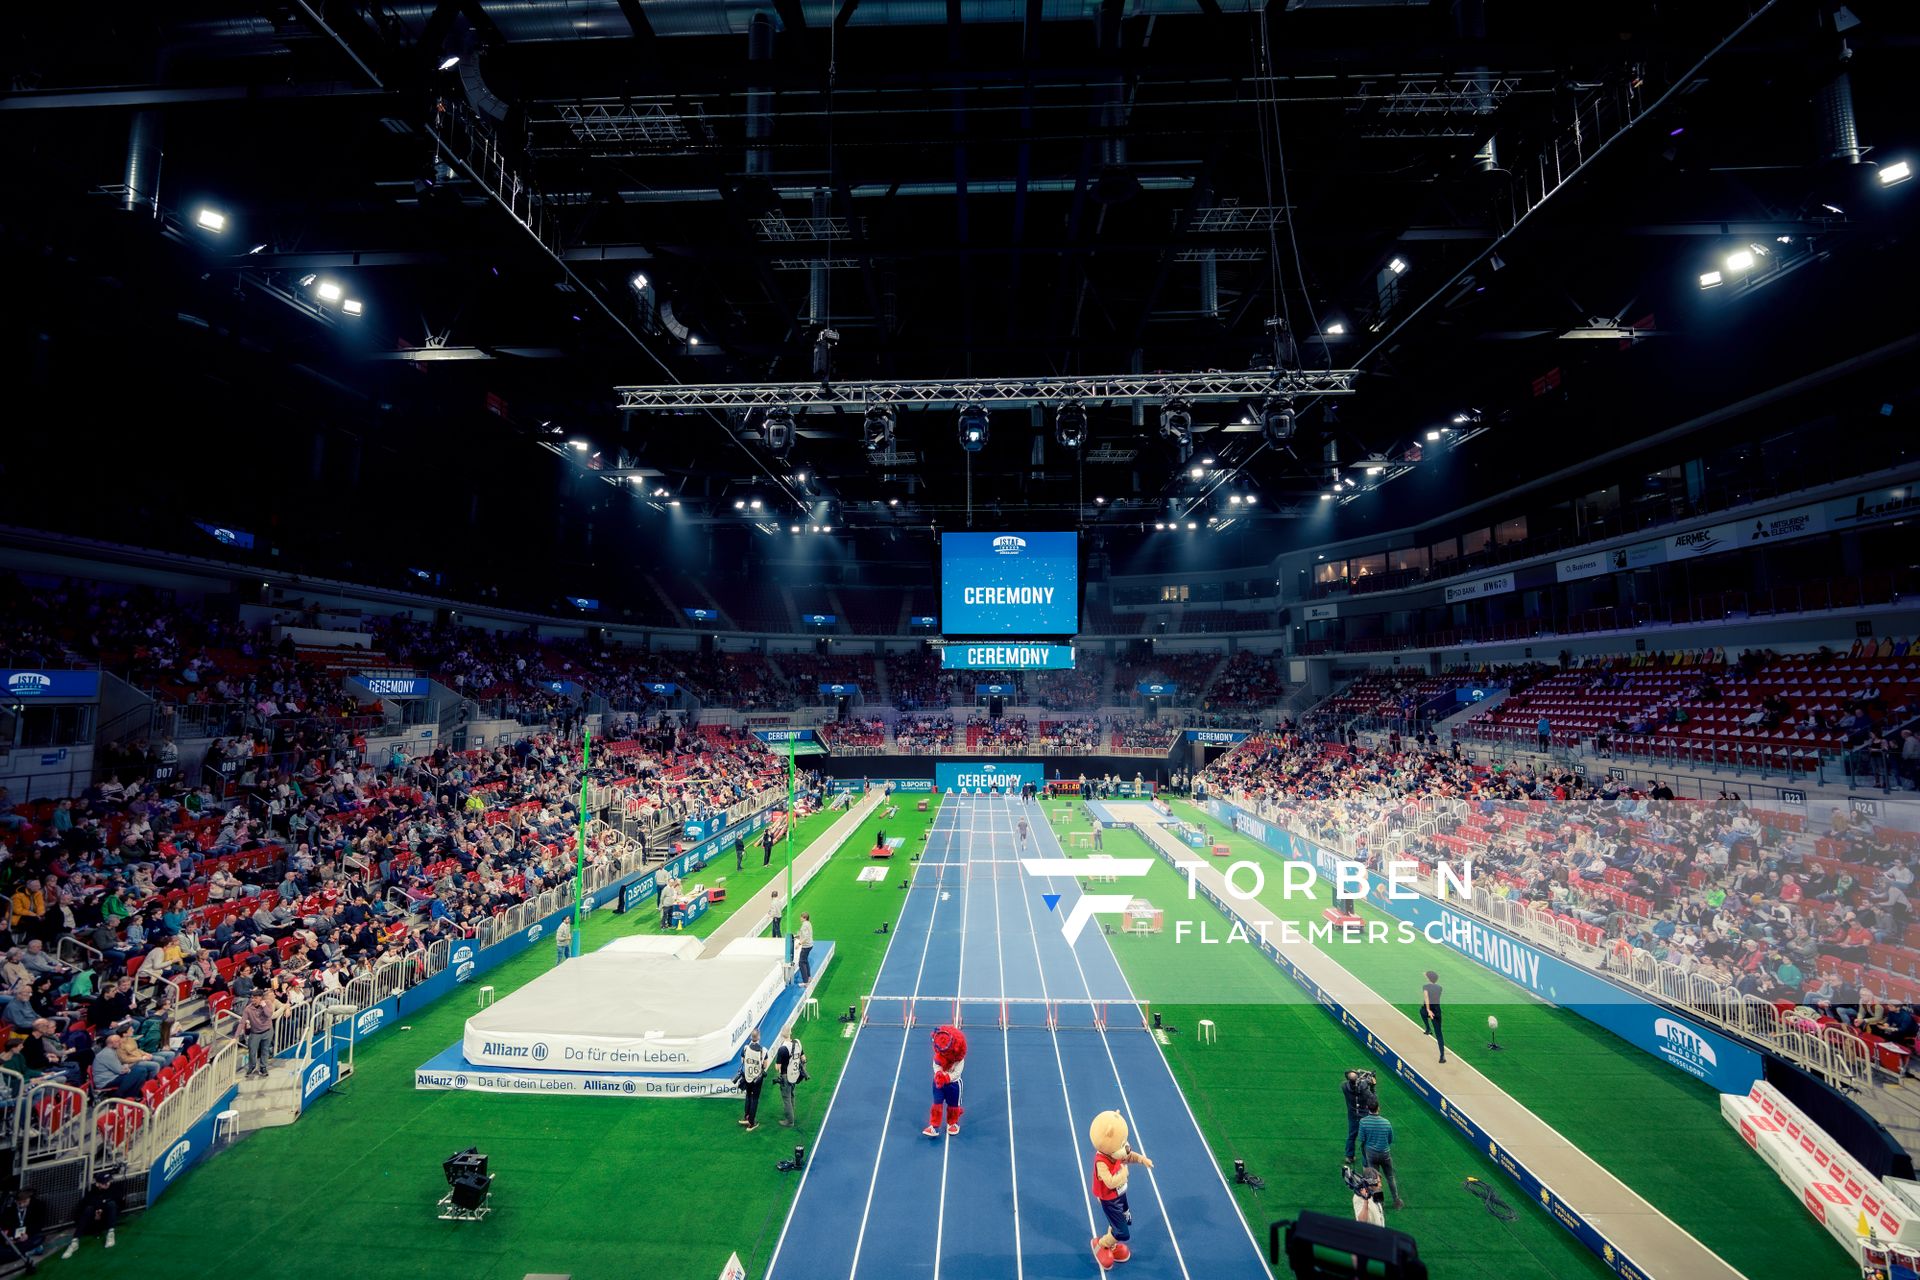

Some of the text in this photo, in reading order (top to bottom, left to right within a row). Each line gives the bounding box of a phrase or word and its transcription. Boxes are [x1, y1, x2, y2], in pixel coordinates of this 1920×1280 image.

[1769, 514, 1810, 529] MITSUBISHI
[1675, 530, 1711, 547] AERMEC
[1771, 524, 1804, 537] ELECTRIC
[1000, 538, 1020, 547] ISTAF
[1573, 561, 1597, 571] Business
[964, 587, 1054, 604] CEREMONY
[967, 647, 1049, 665] CEREMONY
[368, 680, 415, 693] CEREMONY
[1198, 732, 1233, 741] CEREMONY
[156, 767, 173, 779] 007
[222, 761, 236, 772] 008
[957, 774, 1022, 787] CEREMONY
[1784, 792, 1801, 804] 023
[627, 877, 654, 901] D.SPORTS
[1441, 910, 1540, 989] CEREMONY
[1666, 1024, 1702, 1057] ISTAF
[482, 1042, 690, 1063] Allianz Da für dein Leben.
[1667, 1042, 1704, 1066] INDOOR
[747, 1065, 760, 1076] 06
[1668, 1054, 1705, 1078] DÜSSELDORF
[310, 1066, 326, 1091] ISTAF
[417, 1074, 452, 1086] Allianz
[478, 1076, 494, 1087] Da
[496, 1076, 511, 1088] für
[514, 1078, 537, 1089] dein
[539, 1079, 576, 1090] Leben.
[584, 1080, 620, 1091] Allianz
[646, 1082, 662, 1093] Da
[665, 1082, 681, 1093] für
[683, 1083, 707, 1094] dein
